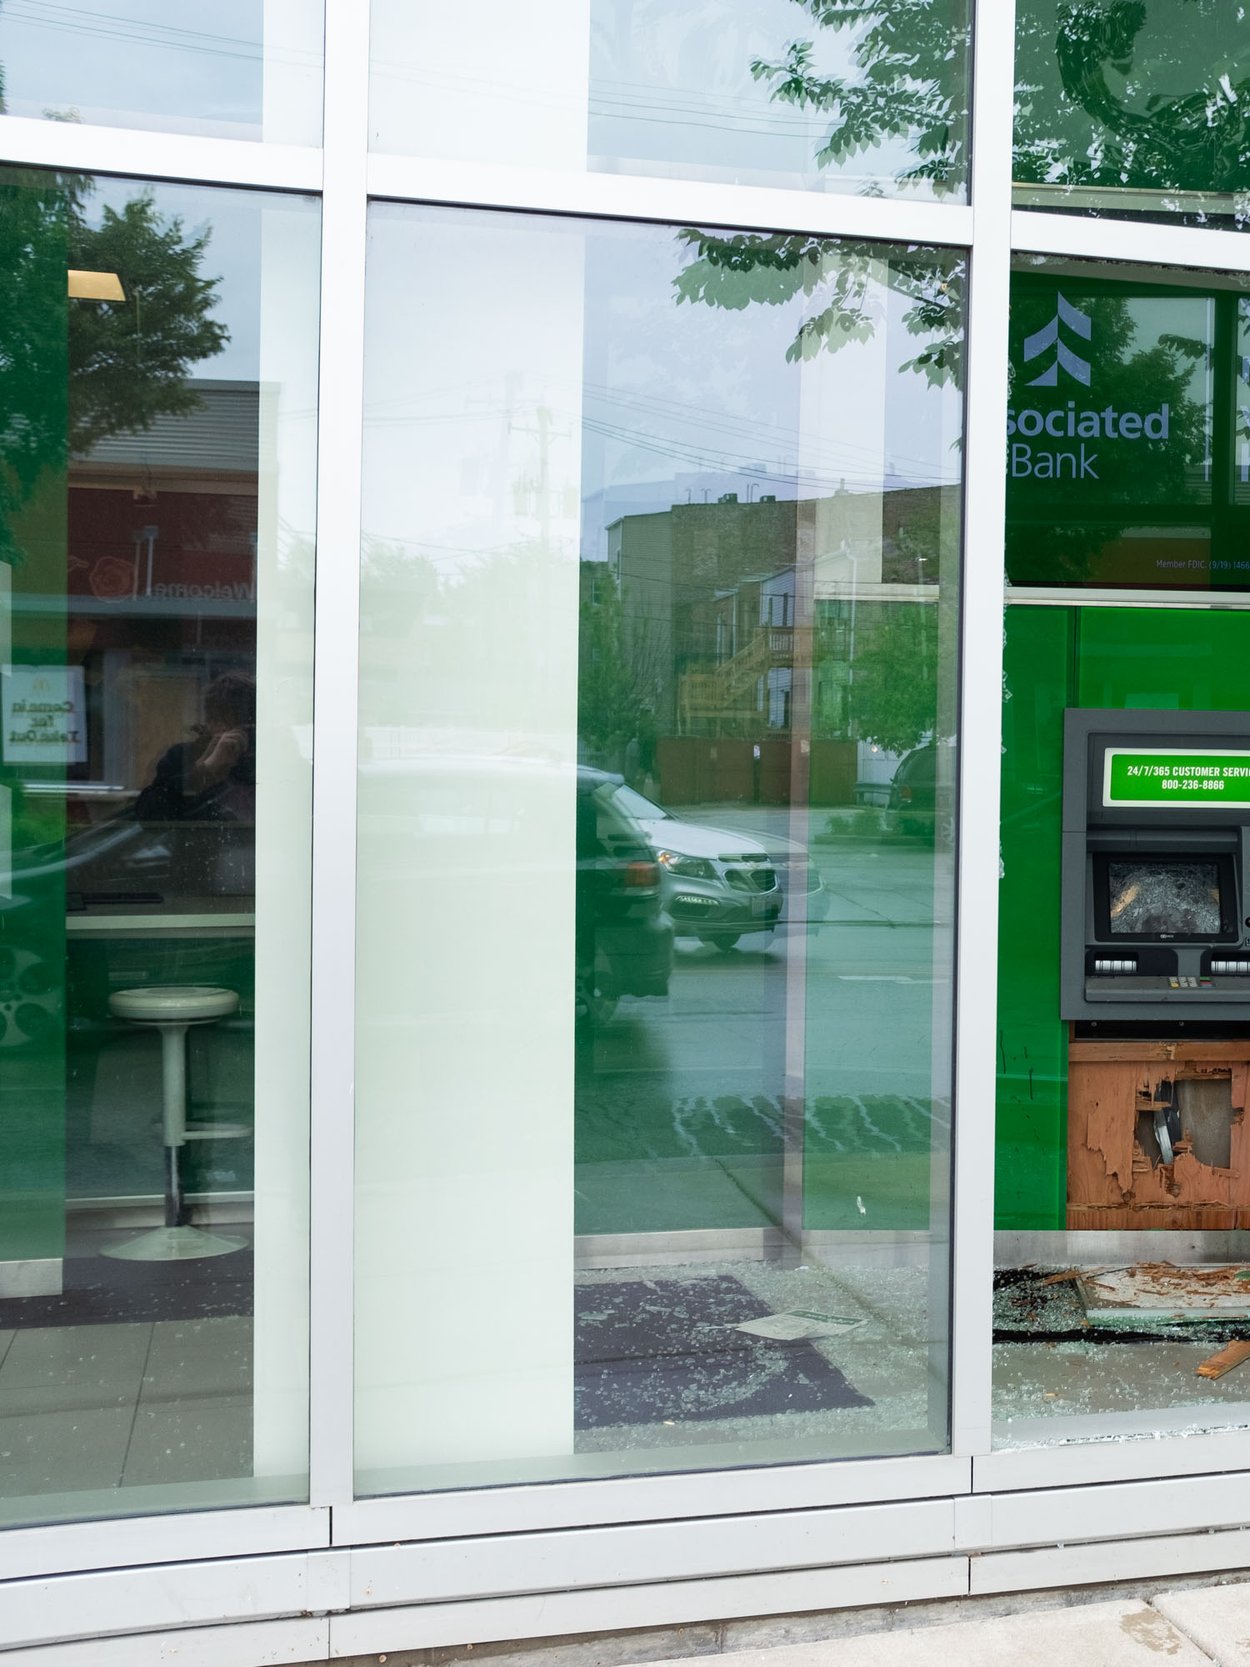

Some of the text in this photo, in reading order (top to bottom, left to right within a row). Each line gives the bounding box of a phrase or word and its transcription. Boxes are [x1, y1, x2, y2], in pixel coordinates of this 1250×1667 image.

[1011, 443, 1100, 480] Bank
[1156, 559, 1186, 570] Member
[1127, 765, 1170, 777] 24/7/365
[1172, 766, 1220, 777] CUSTOMER
[1161, 779, 1225, 791] 800-236-8866
